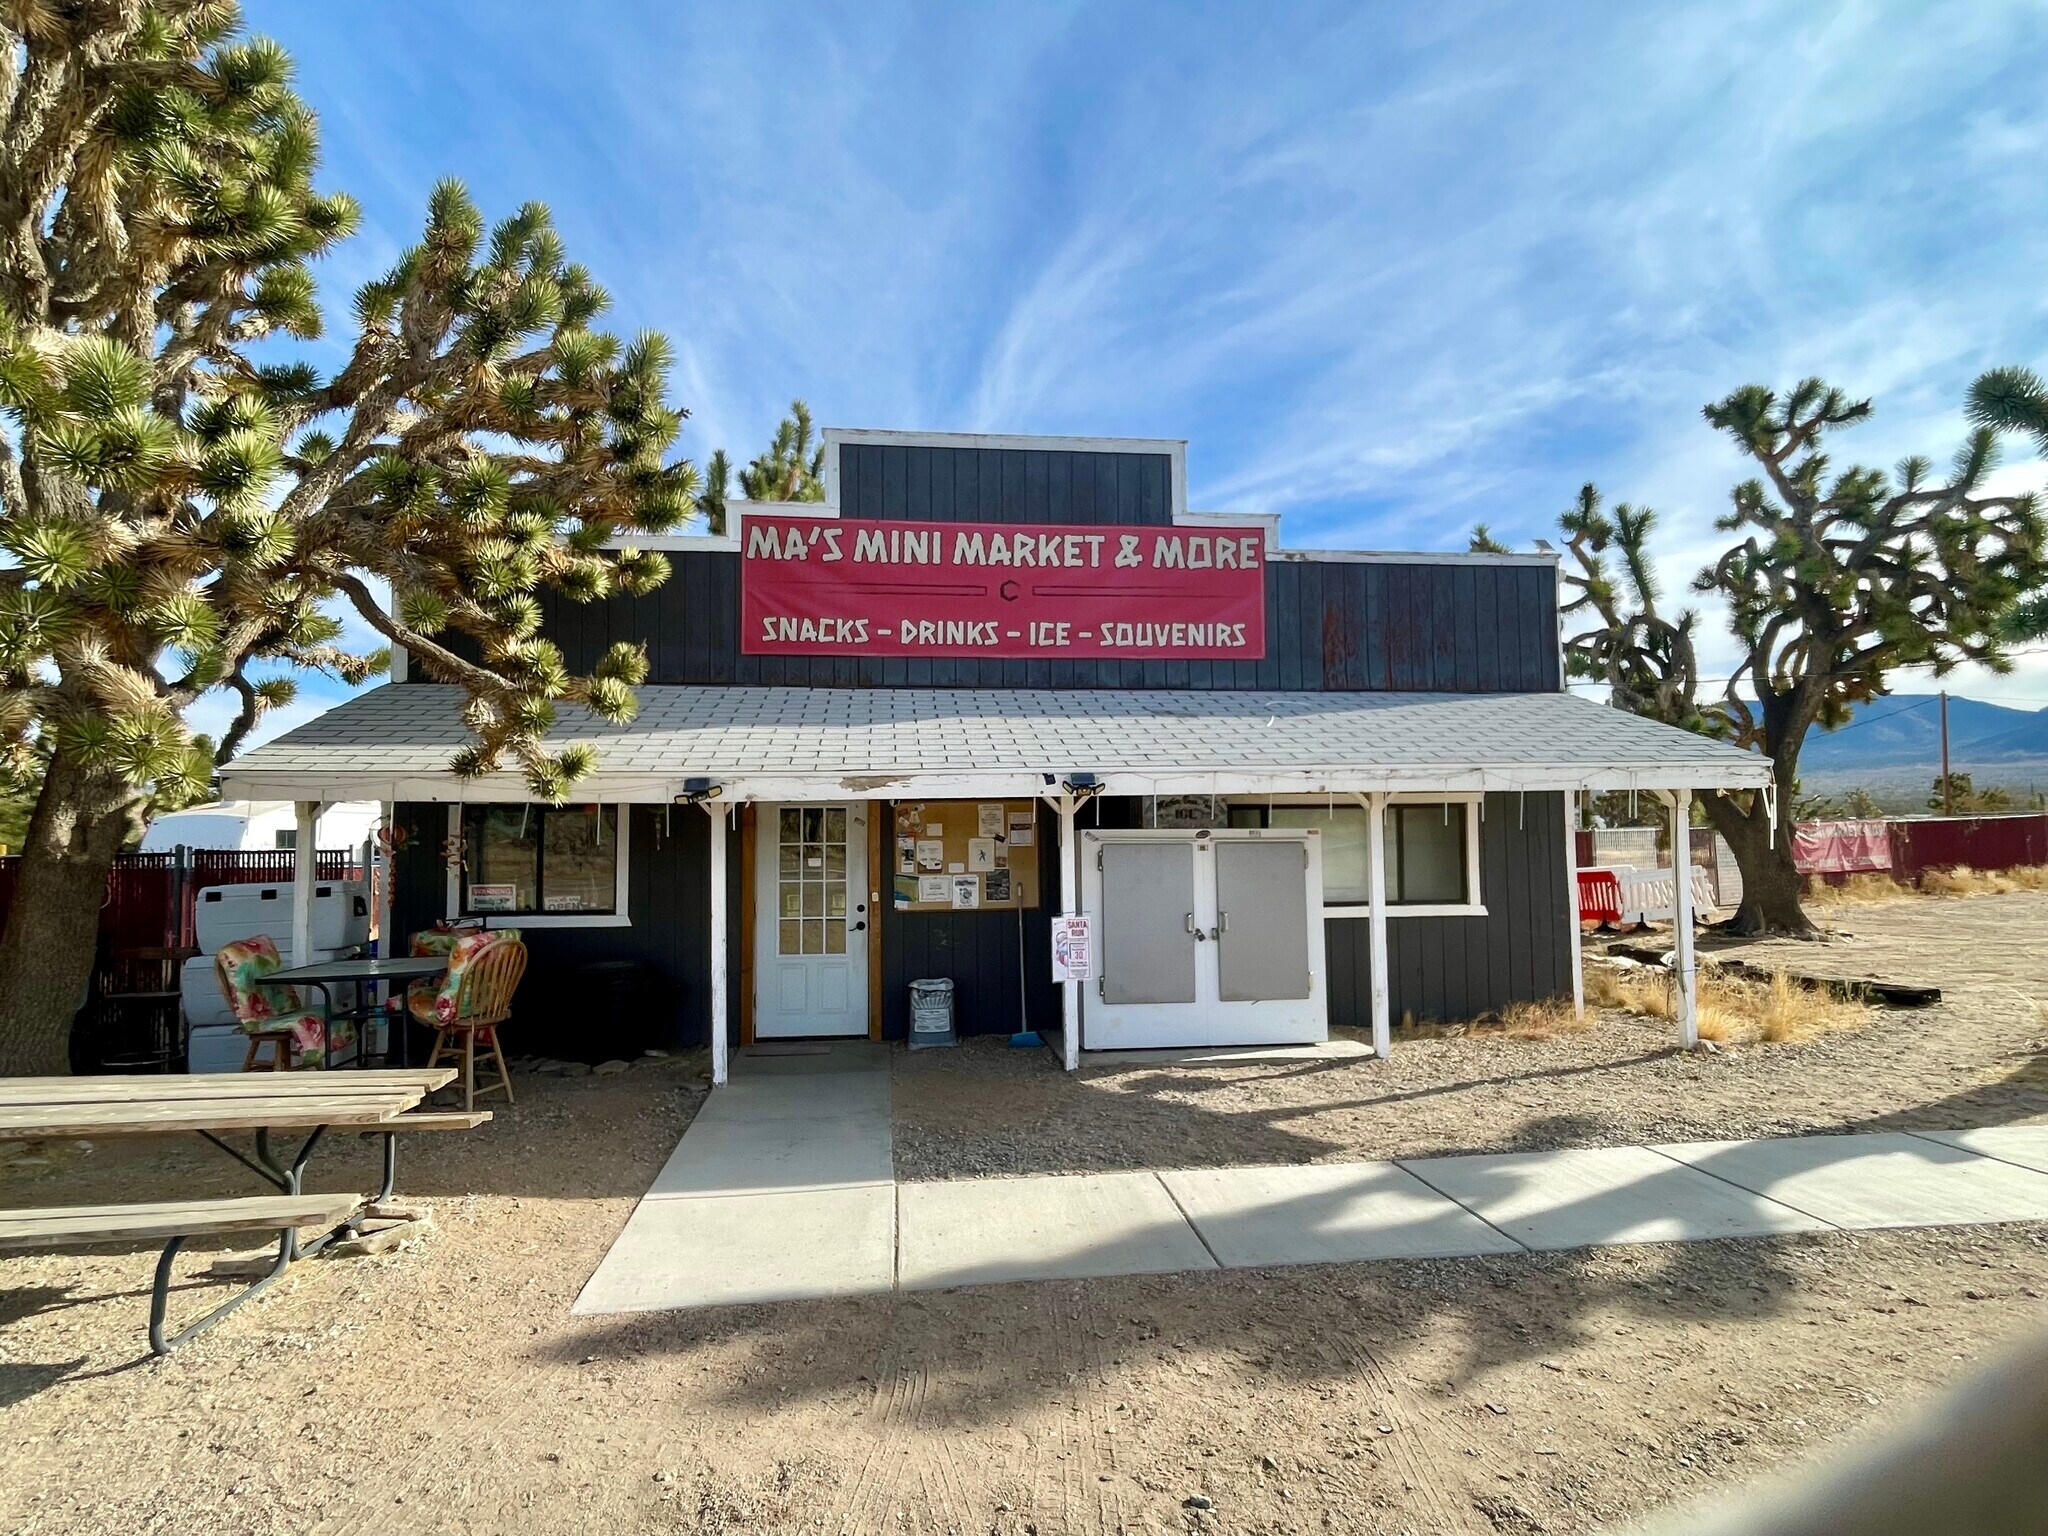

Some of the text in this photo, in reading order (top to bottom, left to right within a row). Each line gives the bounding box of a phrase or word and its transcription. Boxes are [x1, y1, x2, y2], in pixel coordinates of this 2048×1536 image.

[746, 525, 1259, 570] MA'S MINI MARKET & MORE
[762, 616, 870, 644] SNACKS
[900, 619, 999, 646] DRINKS
[1029, 621, 1071, 647] ICE
[1099, 622, 1246, 647] SOUVENIRS
[473, 887, 512, 895] WARNING
[548, 902, 580, 911] OPEN
[1067, 920, 1088, 929] SANTA
[1071, 929, 1084, 937] RUN
[1074, 951, 1084, 960] 30
